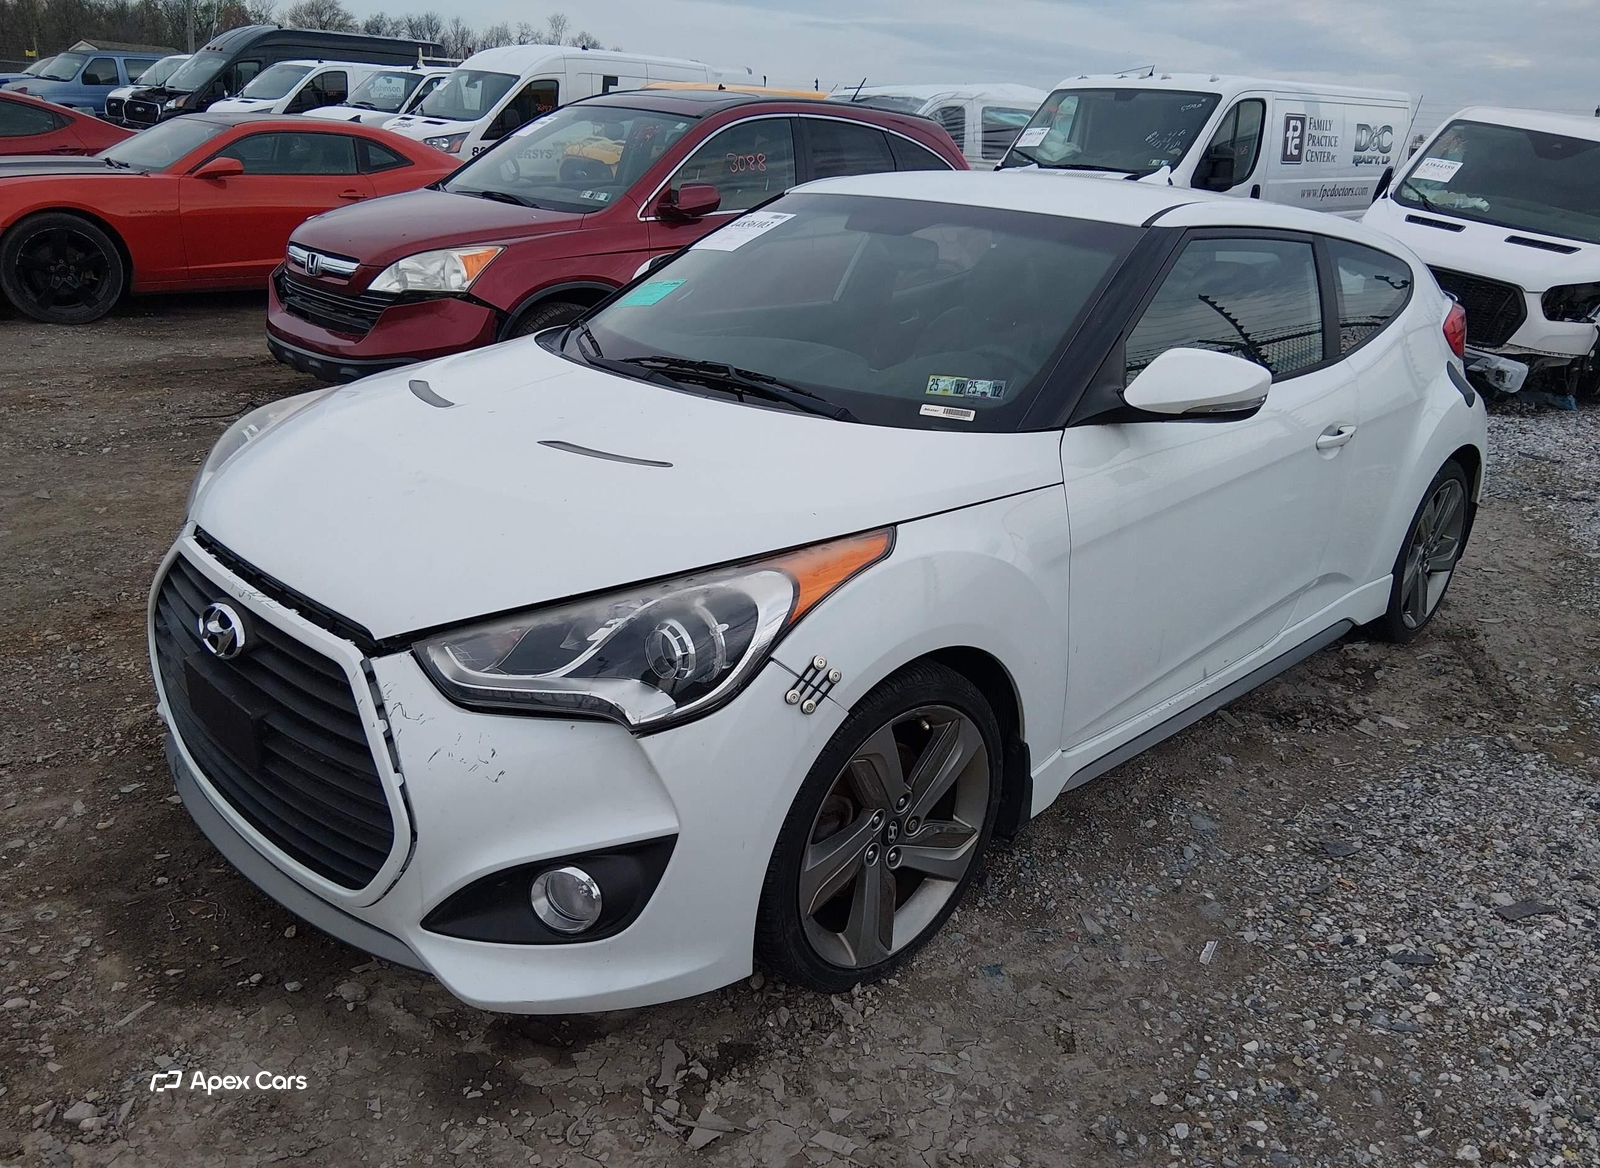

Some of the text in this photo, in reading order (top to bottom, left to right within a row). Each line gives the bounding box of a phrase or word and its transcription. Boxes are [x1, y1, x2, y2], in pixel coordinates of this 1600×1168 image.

[1308, 117, 1334, 132] FAMILY
[1306, 133, 1339, 148] PRACTICE
[1354, 123, 1393, 154] D&C
[726, 152, 766, 173] 3088
[1305, 149, 1331, 163] CENTER
[1300, 184, 1369, 201] www.fpcdoctors.com
[929, 378, 965, 395] 25 12
[967, 380, 1003, 397] 25 12
